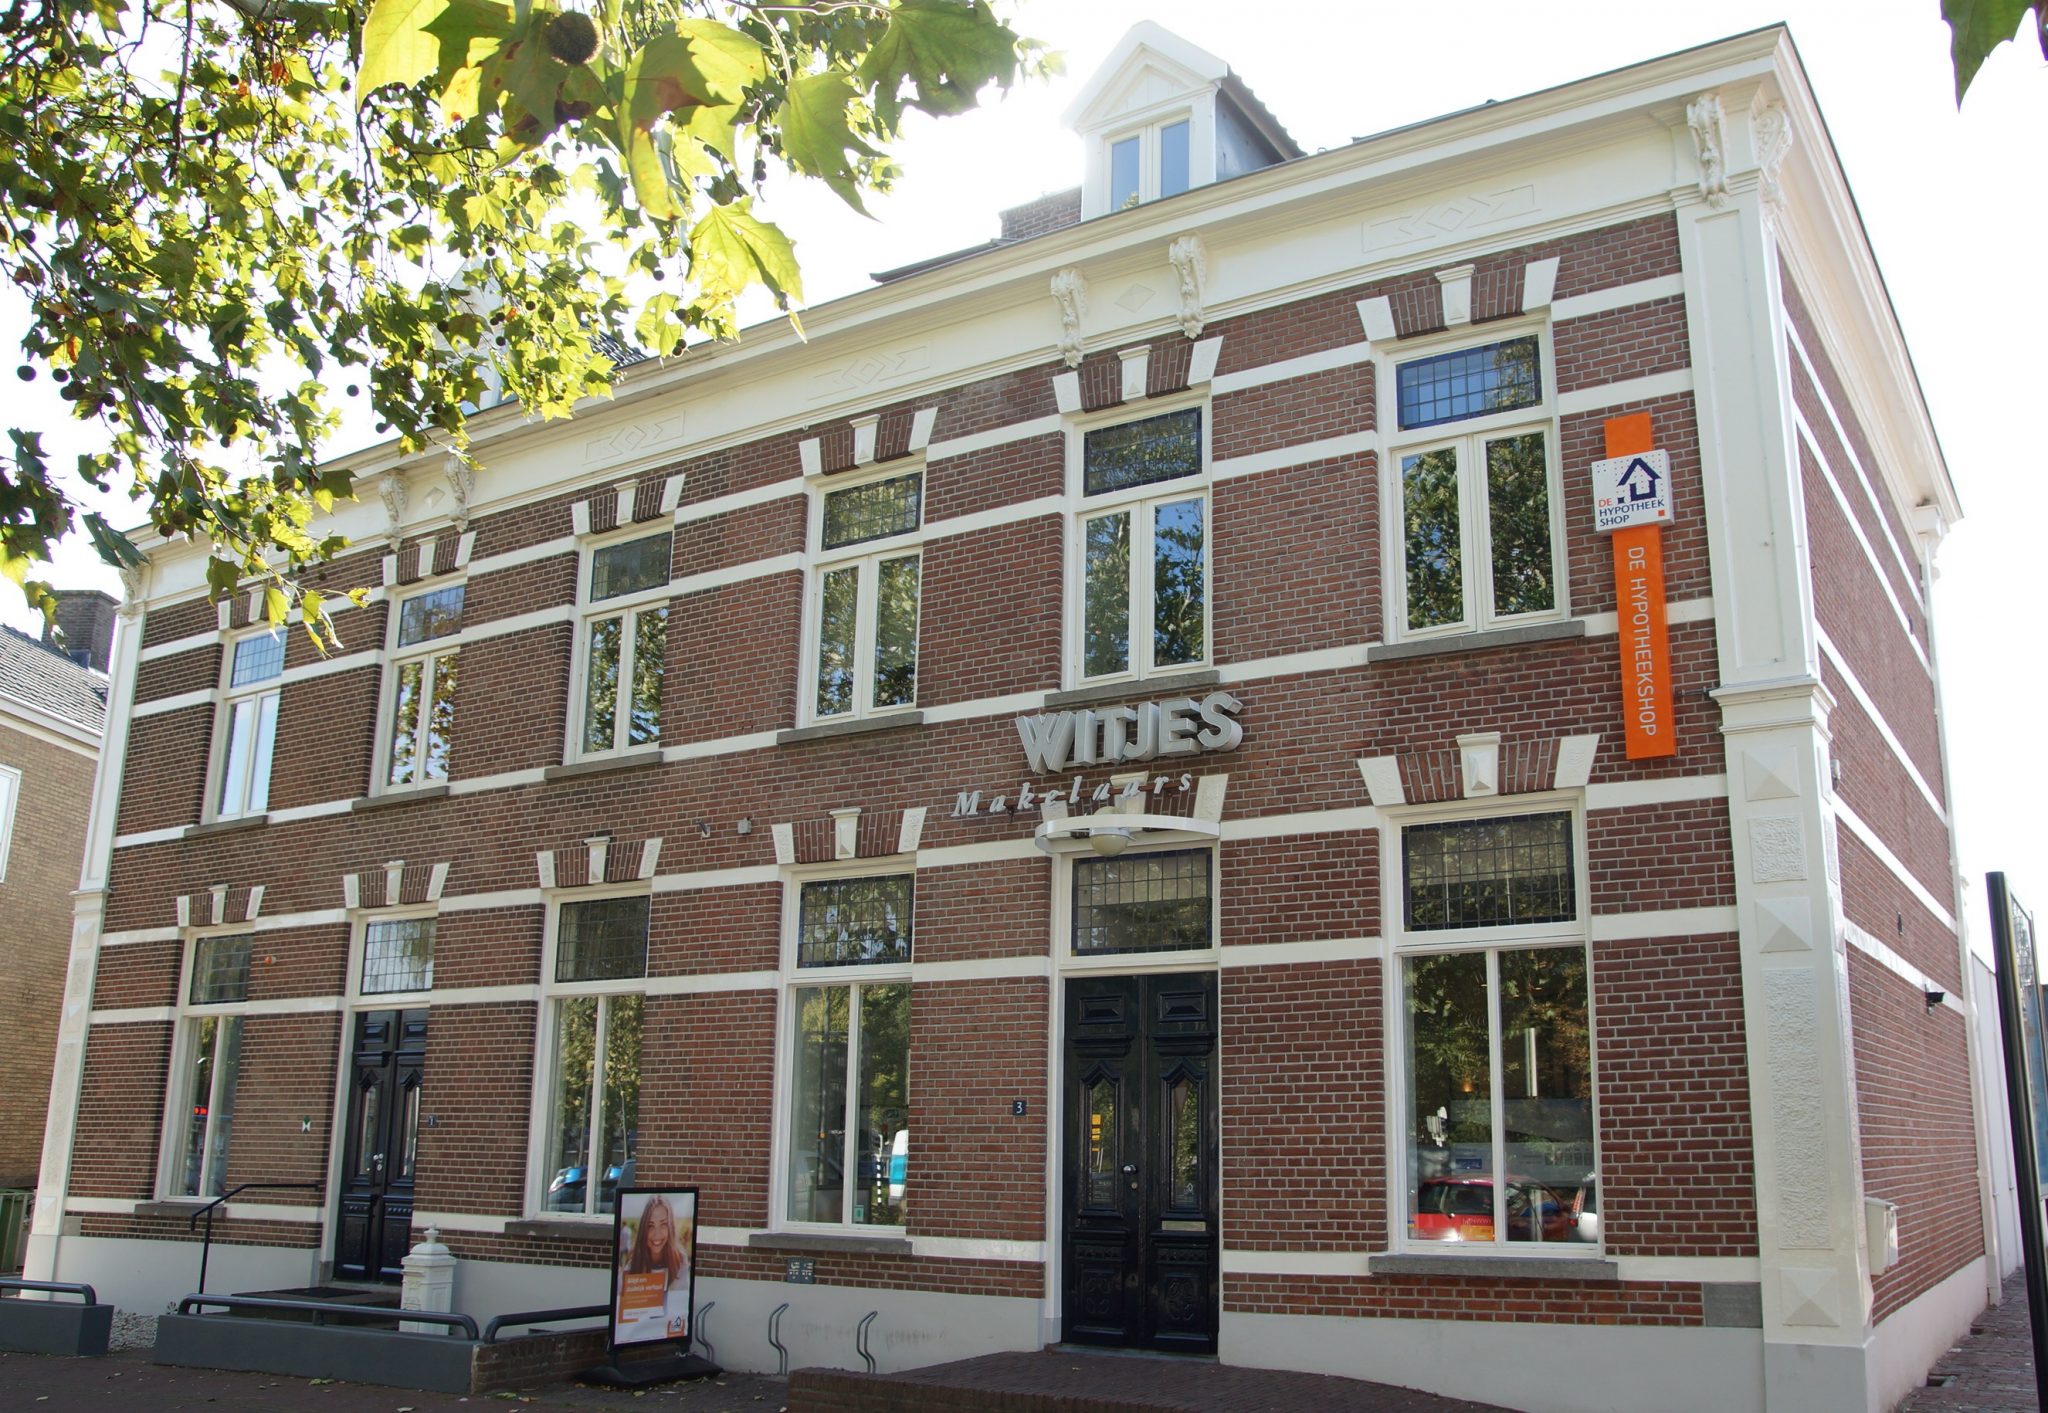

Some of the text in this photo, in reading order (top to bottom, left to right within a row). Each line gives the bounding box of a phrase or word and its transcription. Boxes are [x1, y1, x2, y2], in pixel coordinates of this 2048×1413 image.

[1598, 498, 1612, 507] DE
[1599, 499, 1665, 517] HYPOTHEEK
[1600, 514, 1630, 527] SHOP
[1628, 546, 1657, 736] DE HYPOTHEEKSHOP
[1014, 691, 1244, 775] WITJES
[950, 773, 1193, 817] Makelaars
[1016, 1101, 1023, 1114] 3
